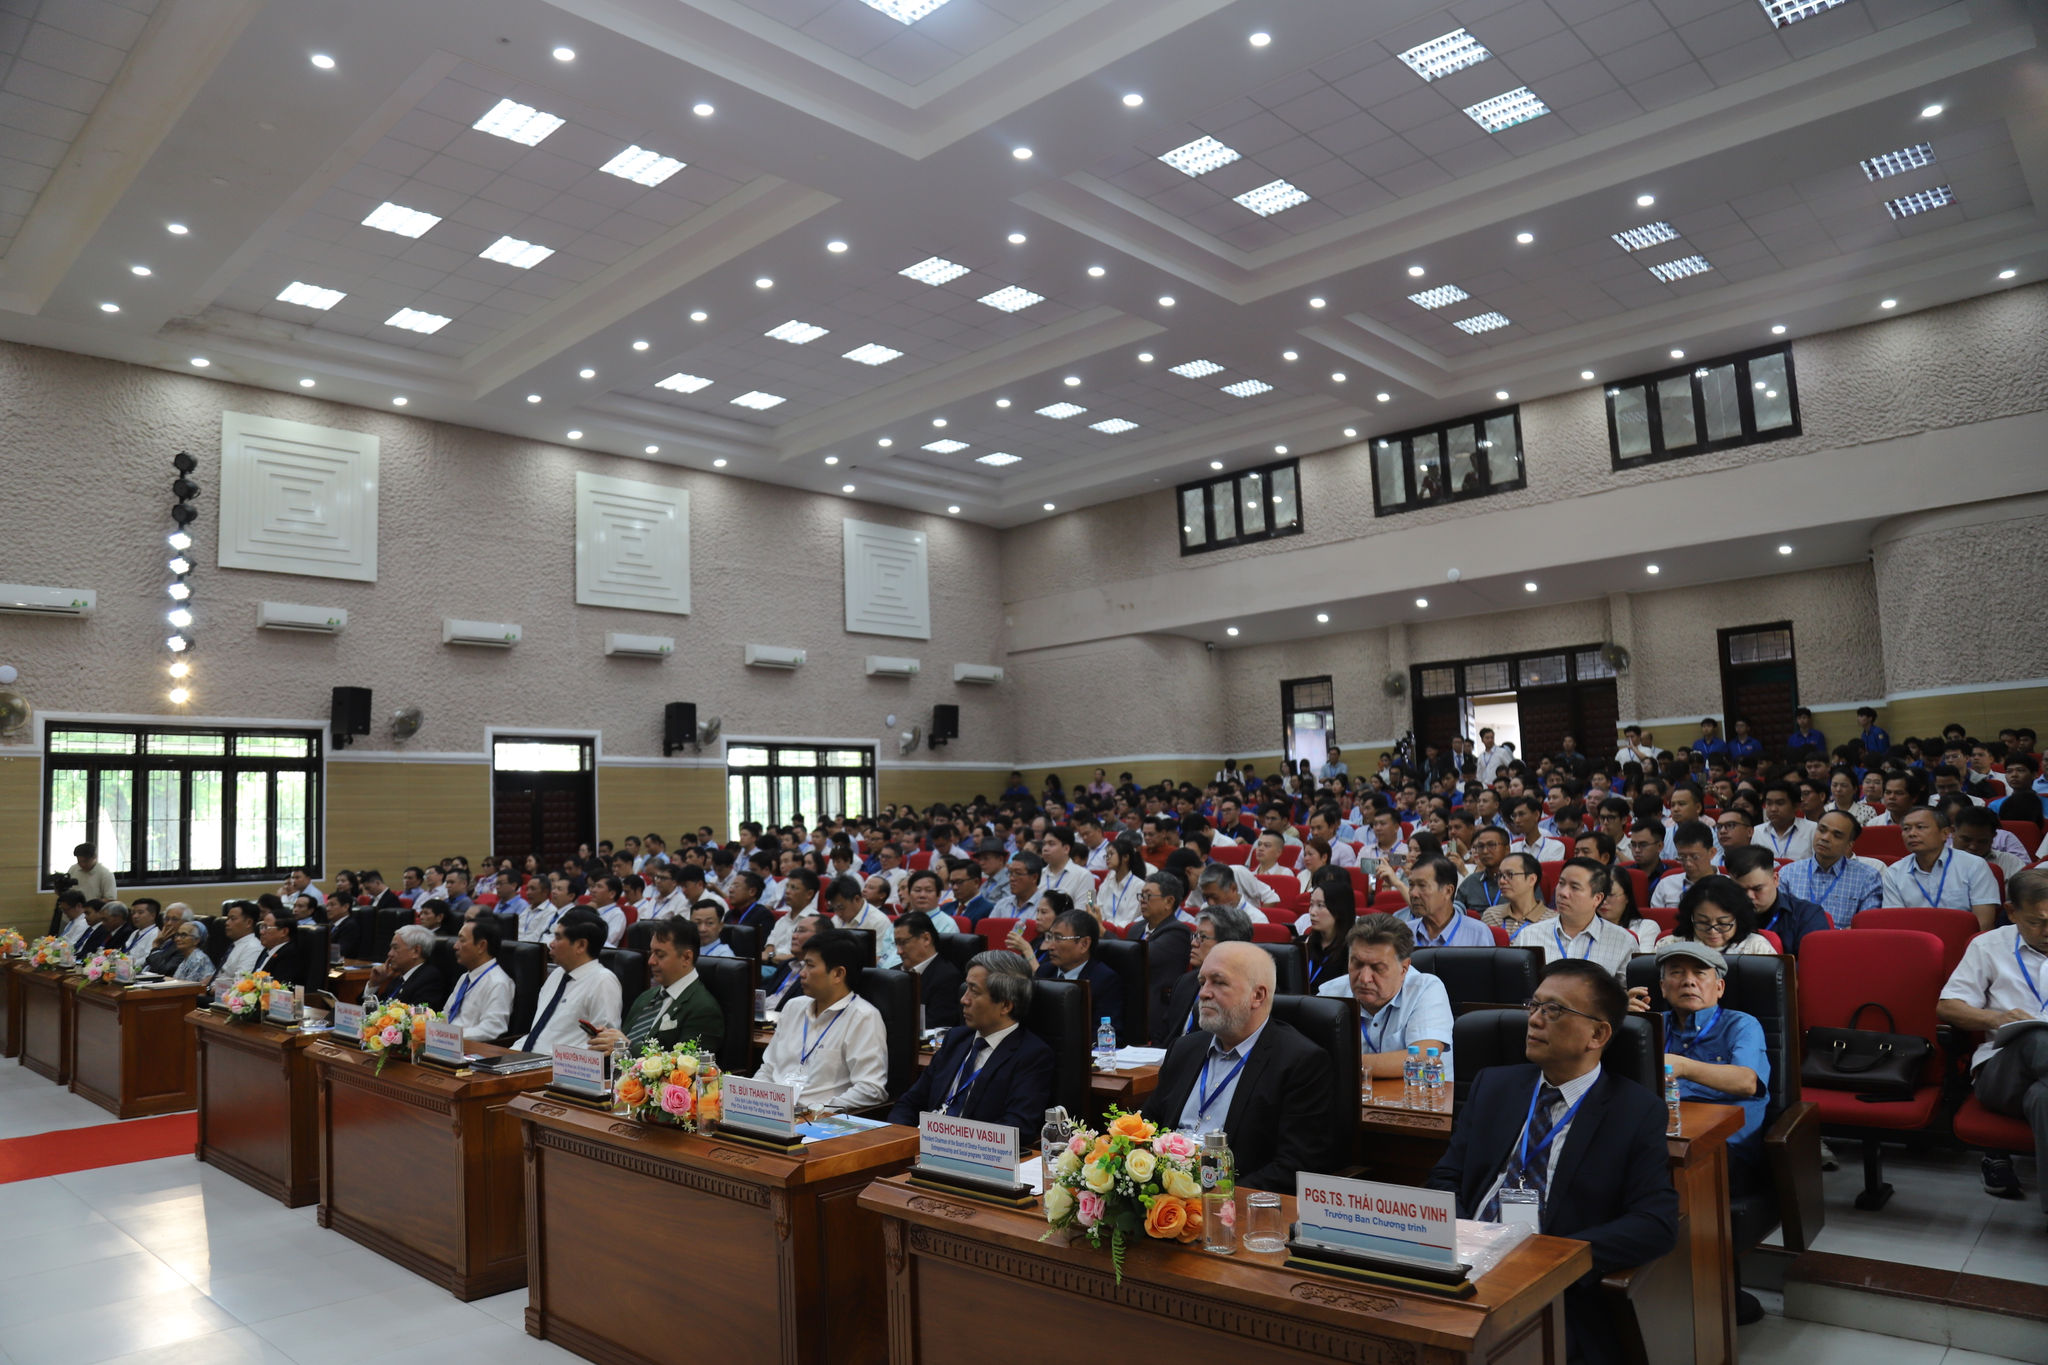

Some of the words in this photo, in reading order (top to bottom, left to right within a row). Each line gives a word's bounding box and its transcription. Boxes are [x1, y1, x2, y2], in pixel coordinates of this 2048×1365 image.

[749, 1087, 768, 1099] THANH
[927, 1120, 974, 1139] KOSHCHIEV
[976, 1128, 1006, 1145] VASILII
[1305, 1187, 1346, 1207] PGS.TS.
[1348, 1193, 1373, 1211] THÁI
[1377, 1199, 1417, 1219] QUANG
[1419, 1205, 1447, 1223] VINH
[1355, 1214, 1370, 1224] Ban
